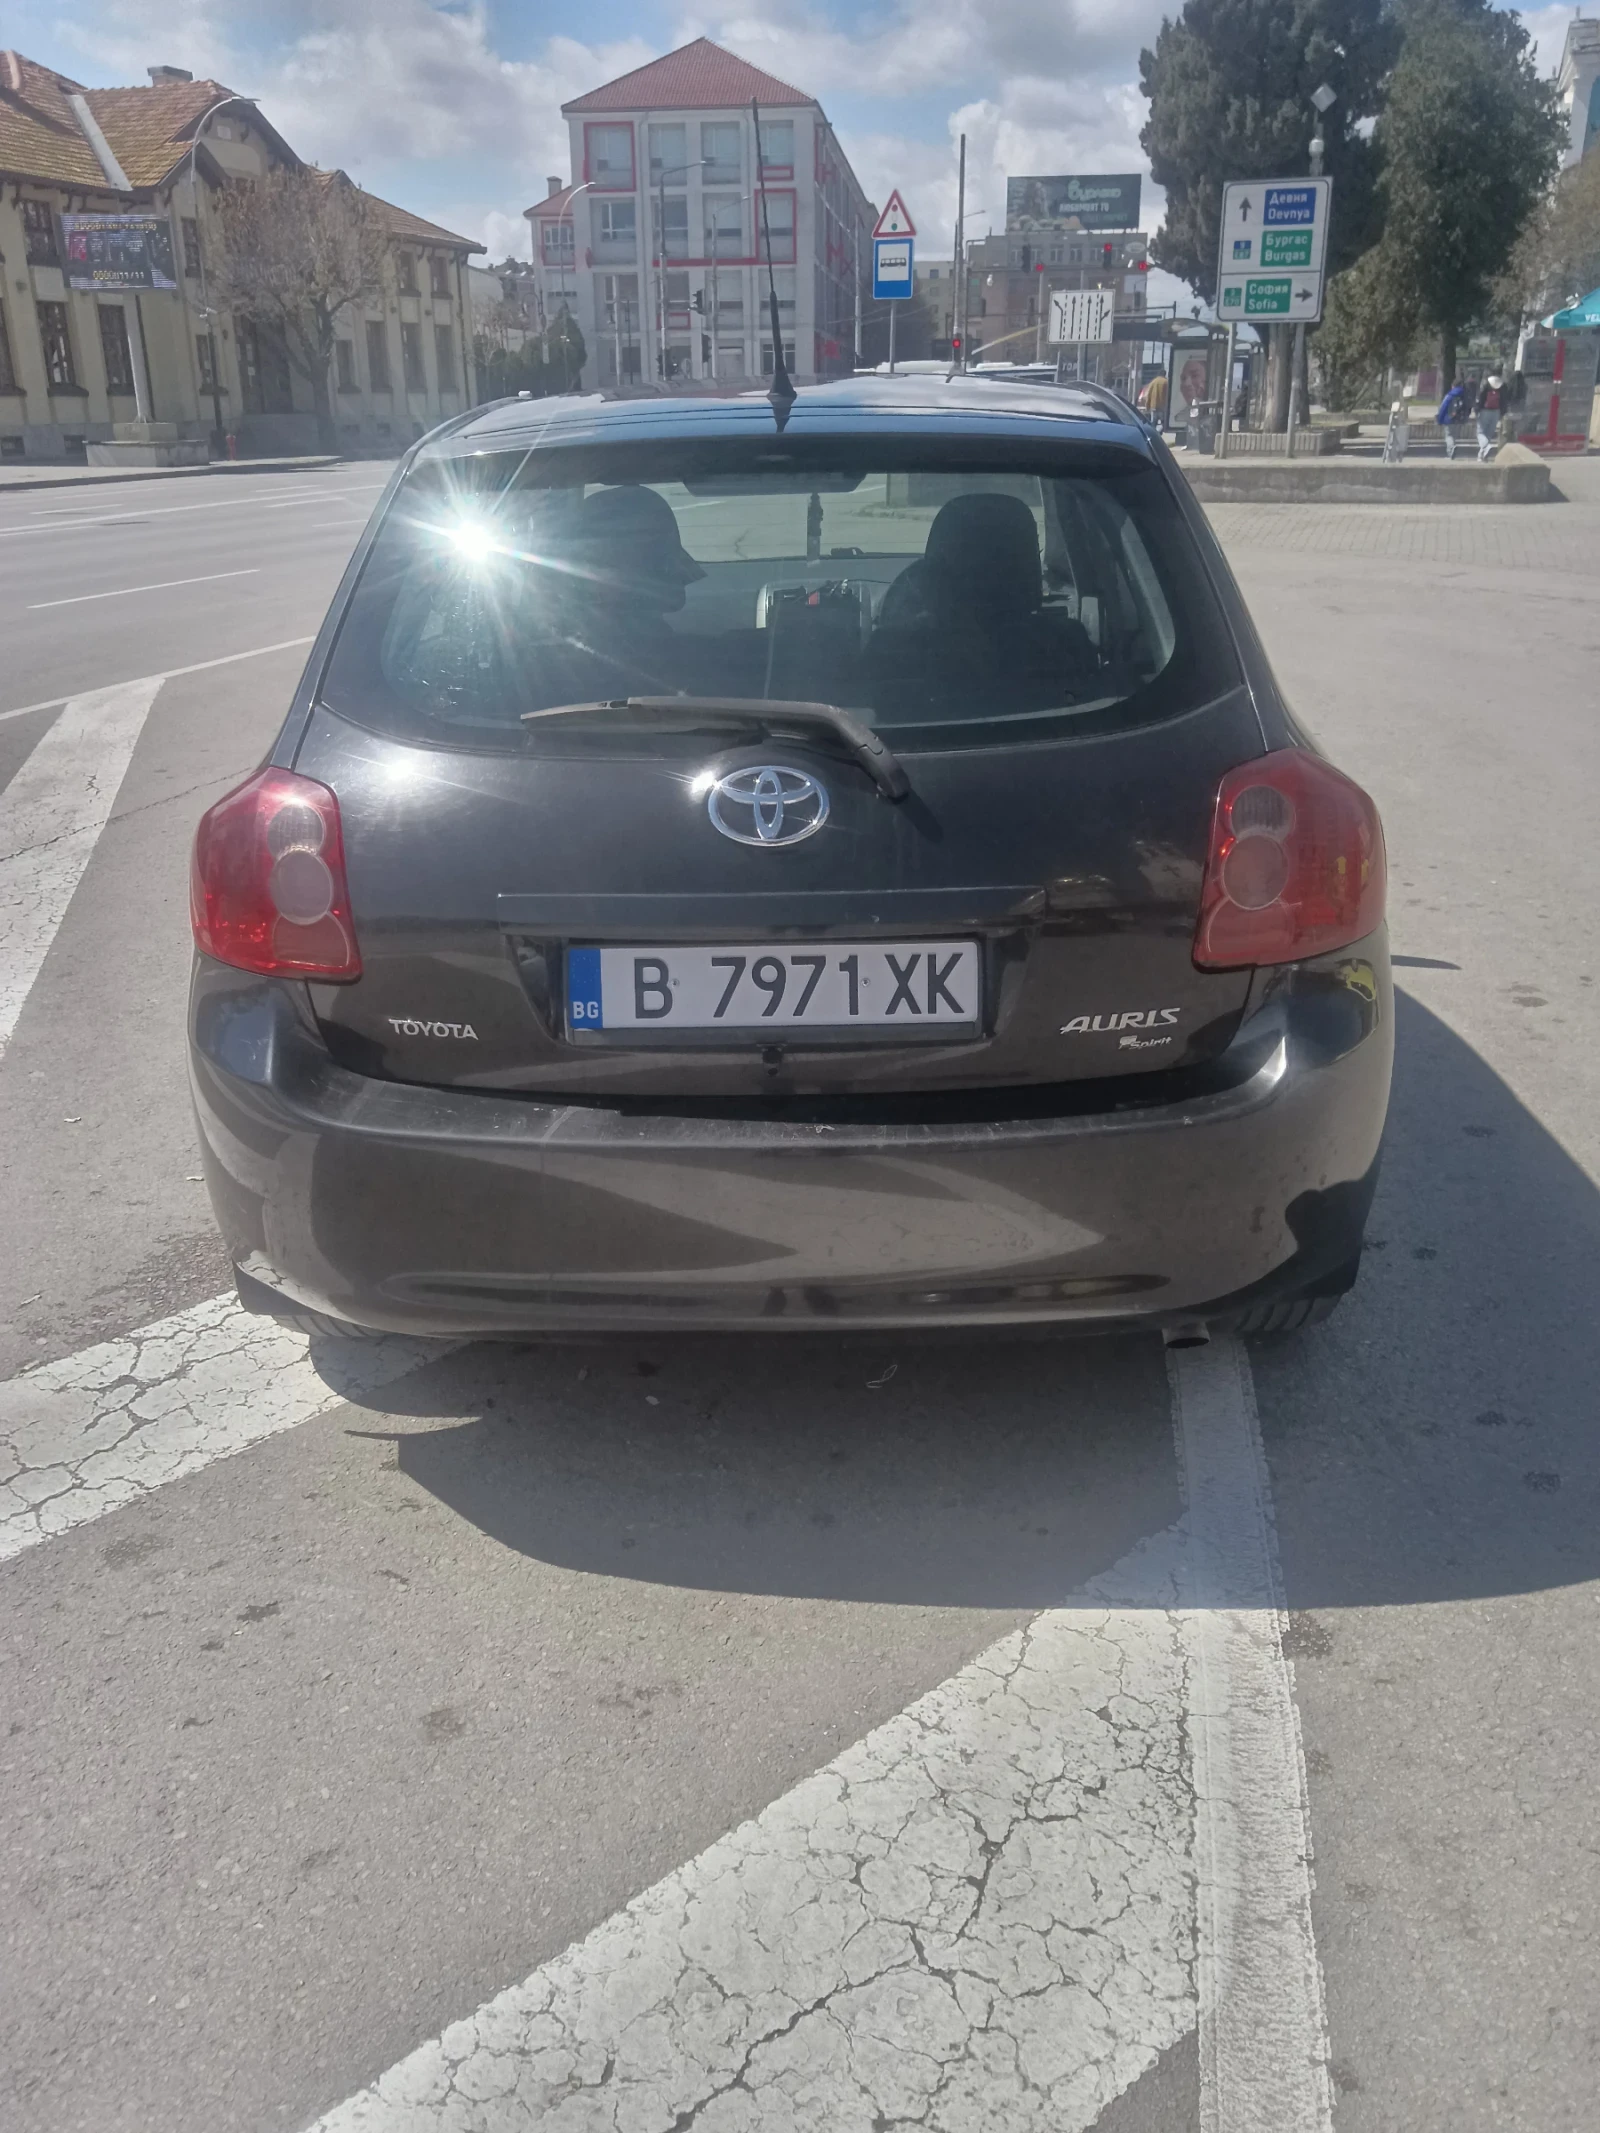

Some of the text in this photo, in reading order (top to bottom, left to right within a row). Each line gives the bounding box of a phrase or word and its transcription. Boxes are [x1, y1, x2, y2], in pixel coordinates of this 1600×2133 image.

[1269, 192, 1308, 205] Девня
[1268, 208, 1310, 221] Devnya
[1266, 234, 1308, 248] Бургас
[1265, 249, 1306, 264] Burgas
[1249, 283, 1289, 295] София
[1248, 299, 1278, 310] Sofia
[633, 953, 965, 1019] B 7971 XK
[572, 1001, 599, 1019] BG
[1060, 1007, 1180, 1034] AURIS
[388, 1019, 479, 1040] TOYOTA
